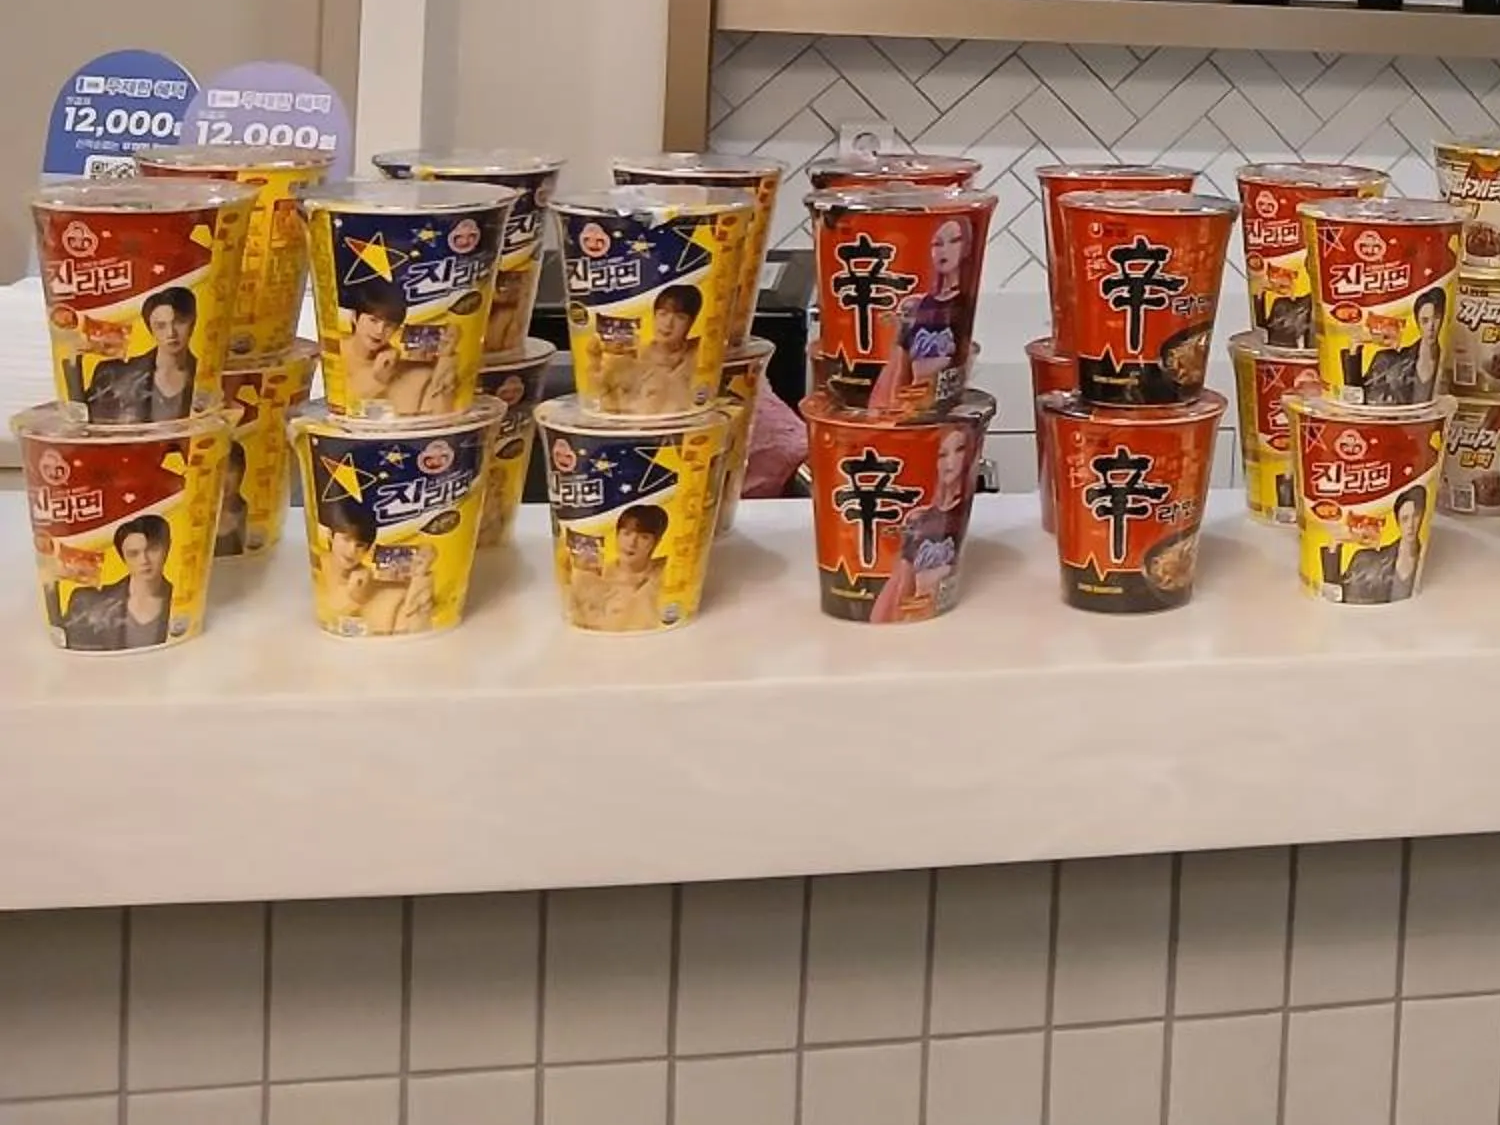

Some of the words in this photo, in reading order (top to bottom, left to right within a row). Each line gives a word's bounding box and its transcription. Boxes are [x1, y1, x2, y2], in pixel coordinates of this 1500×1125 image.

[832, 232, 919, 354] 辛
[1100, 235, 1188, 355] 辛
[1330, 262, 1411, 299] 진라면
[832, 447, 924, 568] 辛
[1082, 445, 1172, 563] 辛
[1312, 461, 1391, 496] 진라면
